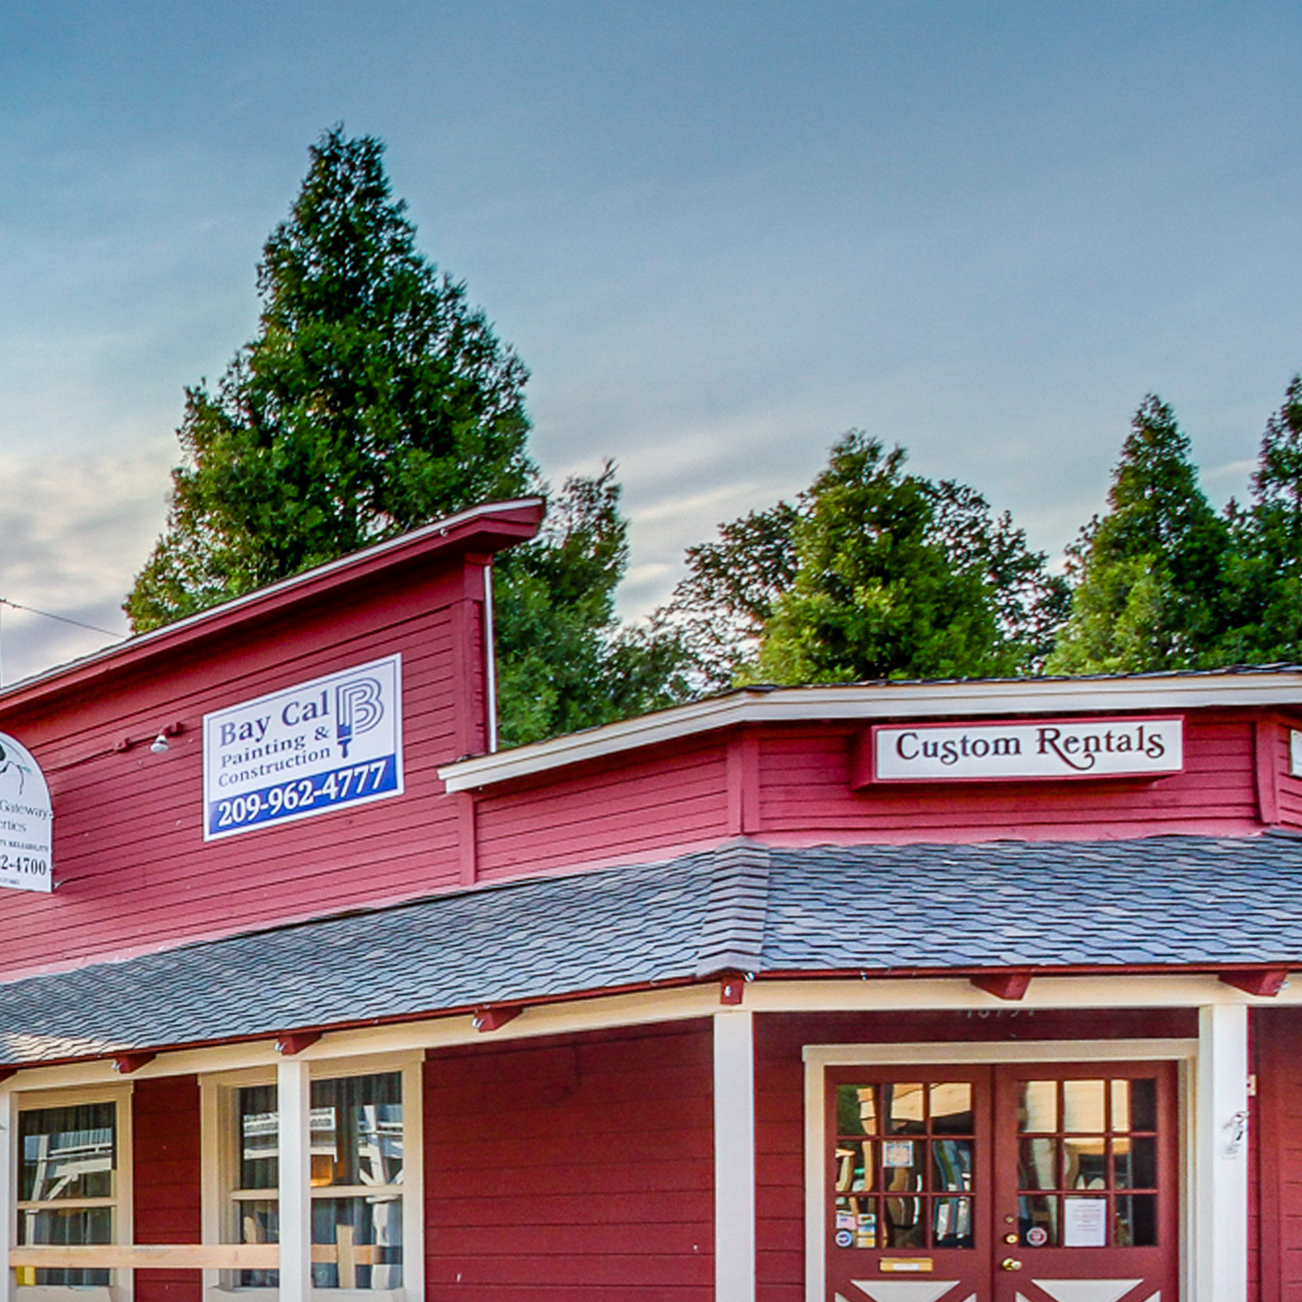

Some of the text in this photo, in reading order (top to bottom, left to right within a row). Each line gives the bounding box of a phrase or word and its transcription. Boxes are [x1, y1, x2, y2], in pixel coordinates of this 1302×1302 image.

[219, 690, 329, 747] Bay Cal
[218, 747, 330, 787] Construction
[221, 726, 329, 768] Painting &
[896, 725, 1165, 770] Custom Rentals
[218, 760, 387, 827] 209-962-4777
